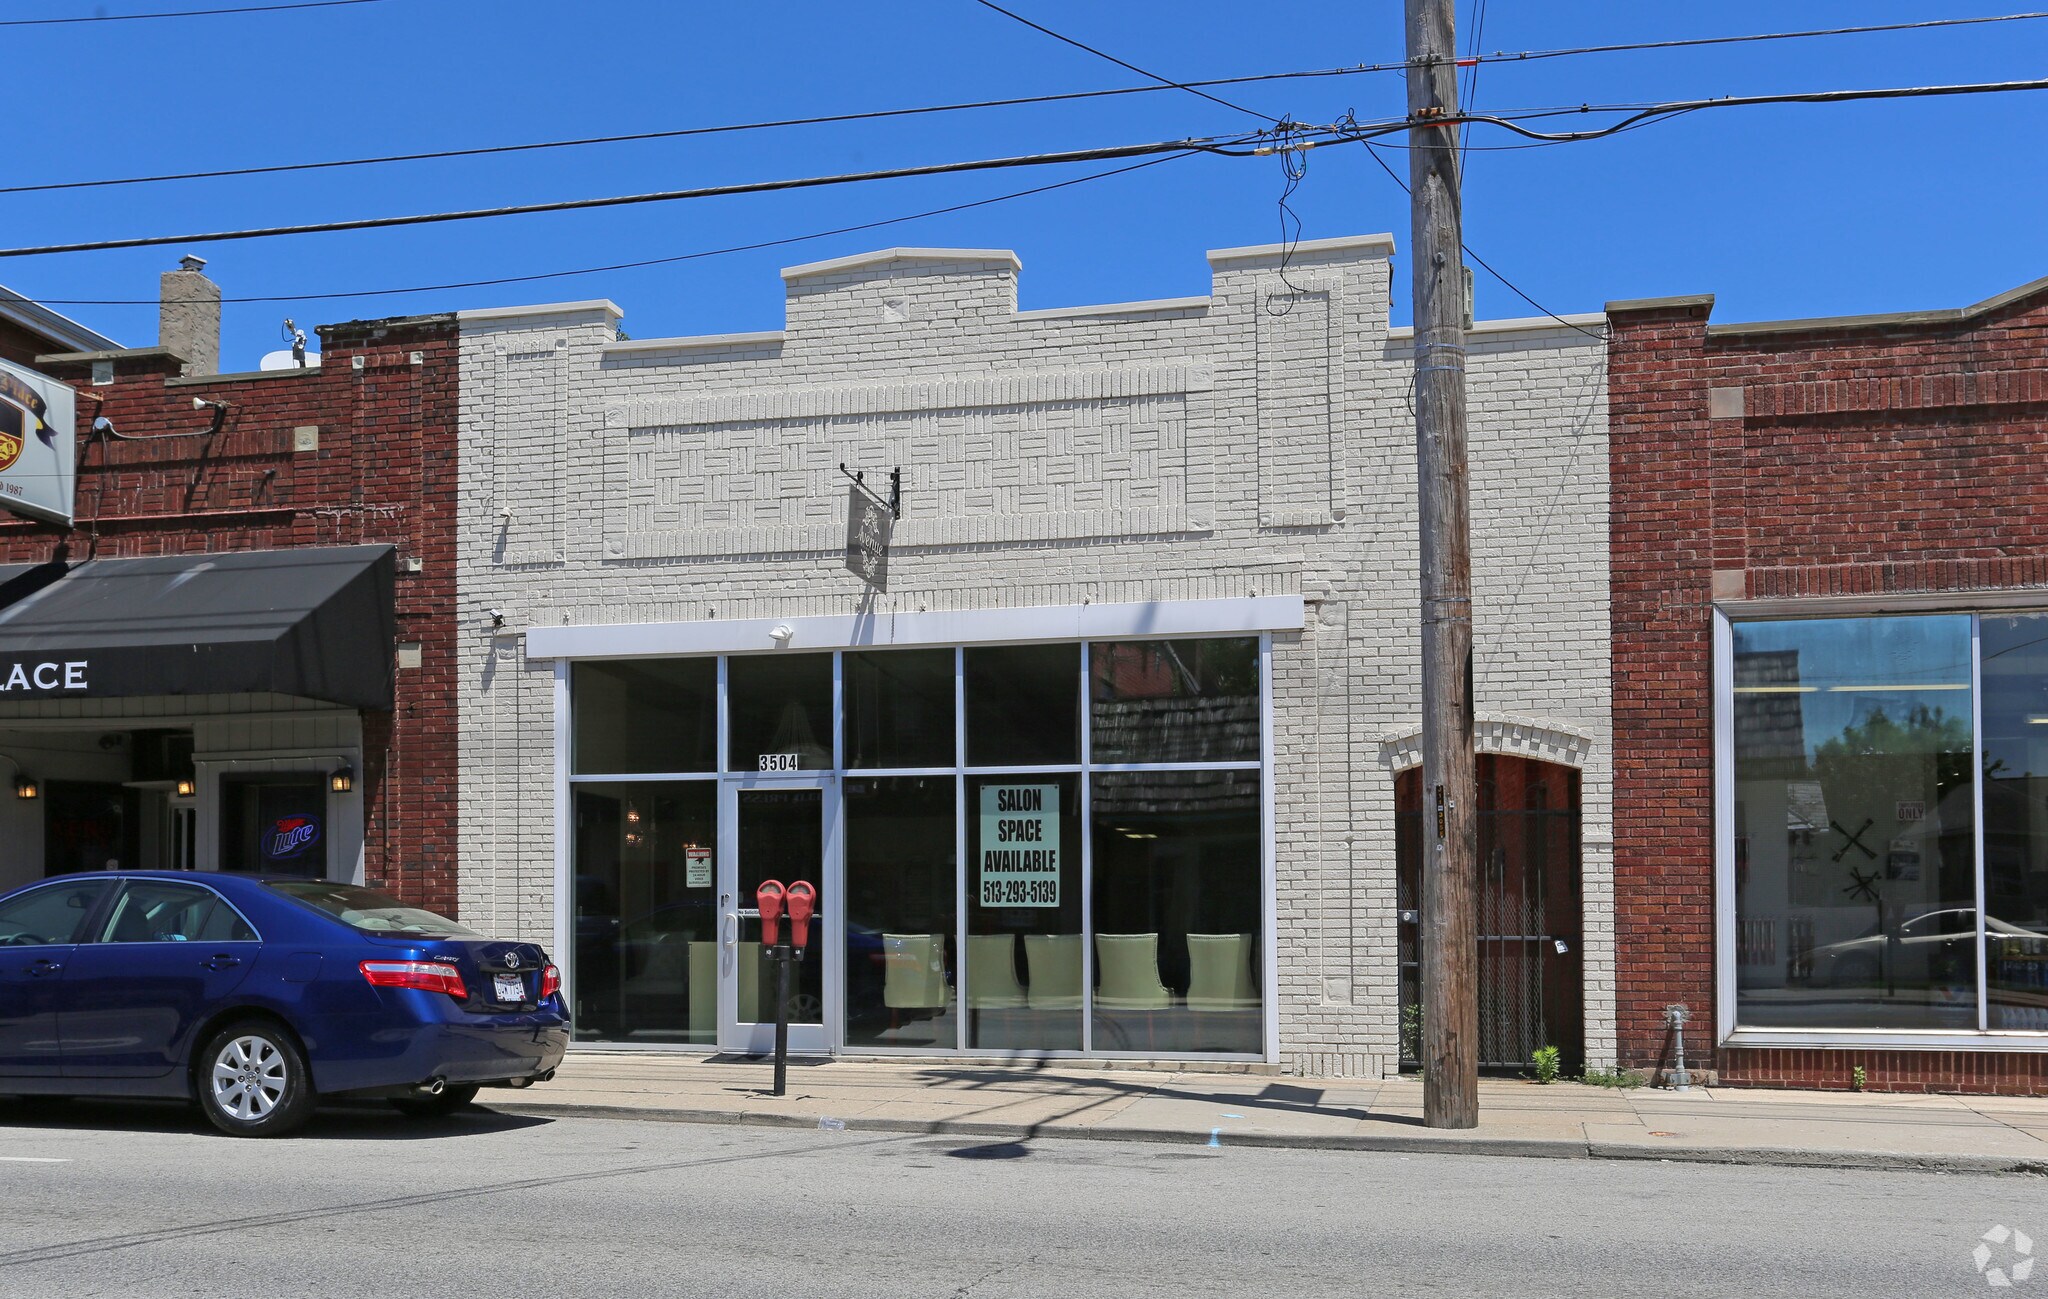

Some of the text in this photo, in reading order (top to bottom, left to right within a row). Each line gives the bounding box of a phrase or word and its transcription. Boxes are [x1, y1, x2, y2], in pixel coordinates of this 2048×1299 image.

[6, 483, 23, 497] 1987
[854, 525, 884, 557] Avenue
[0, 660, 88, 691] ACE
[760, 755, 797, 771] 3504
[998, 789, 1042, 812] SALON
[1898, 808, 1924, 819] ONLY
[998, 819, 1042, 842] SPACE
[984, 850, 1056, 872] AVAILABLE
[983, 880, 1056, 903] 513-293-5139
